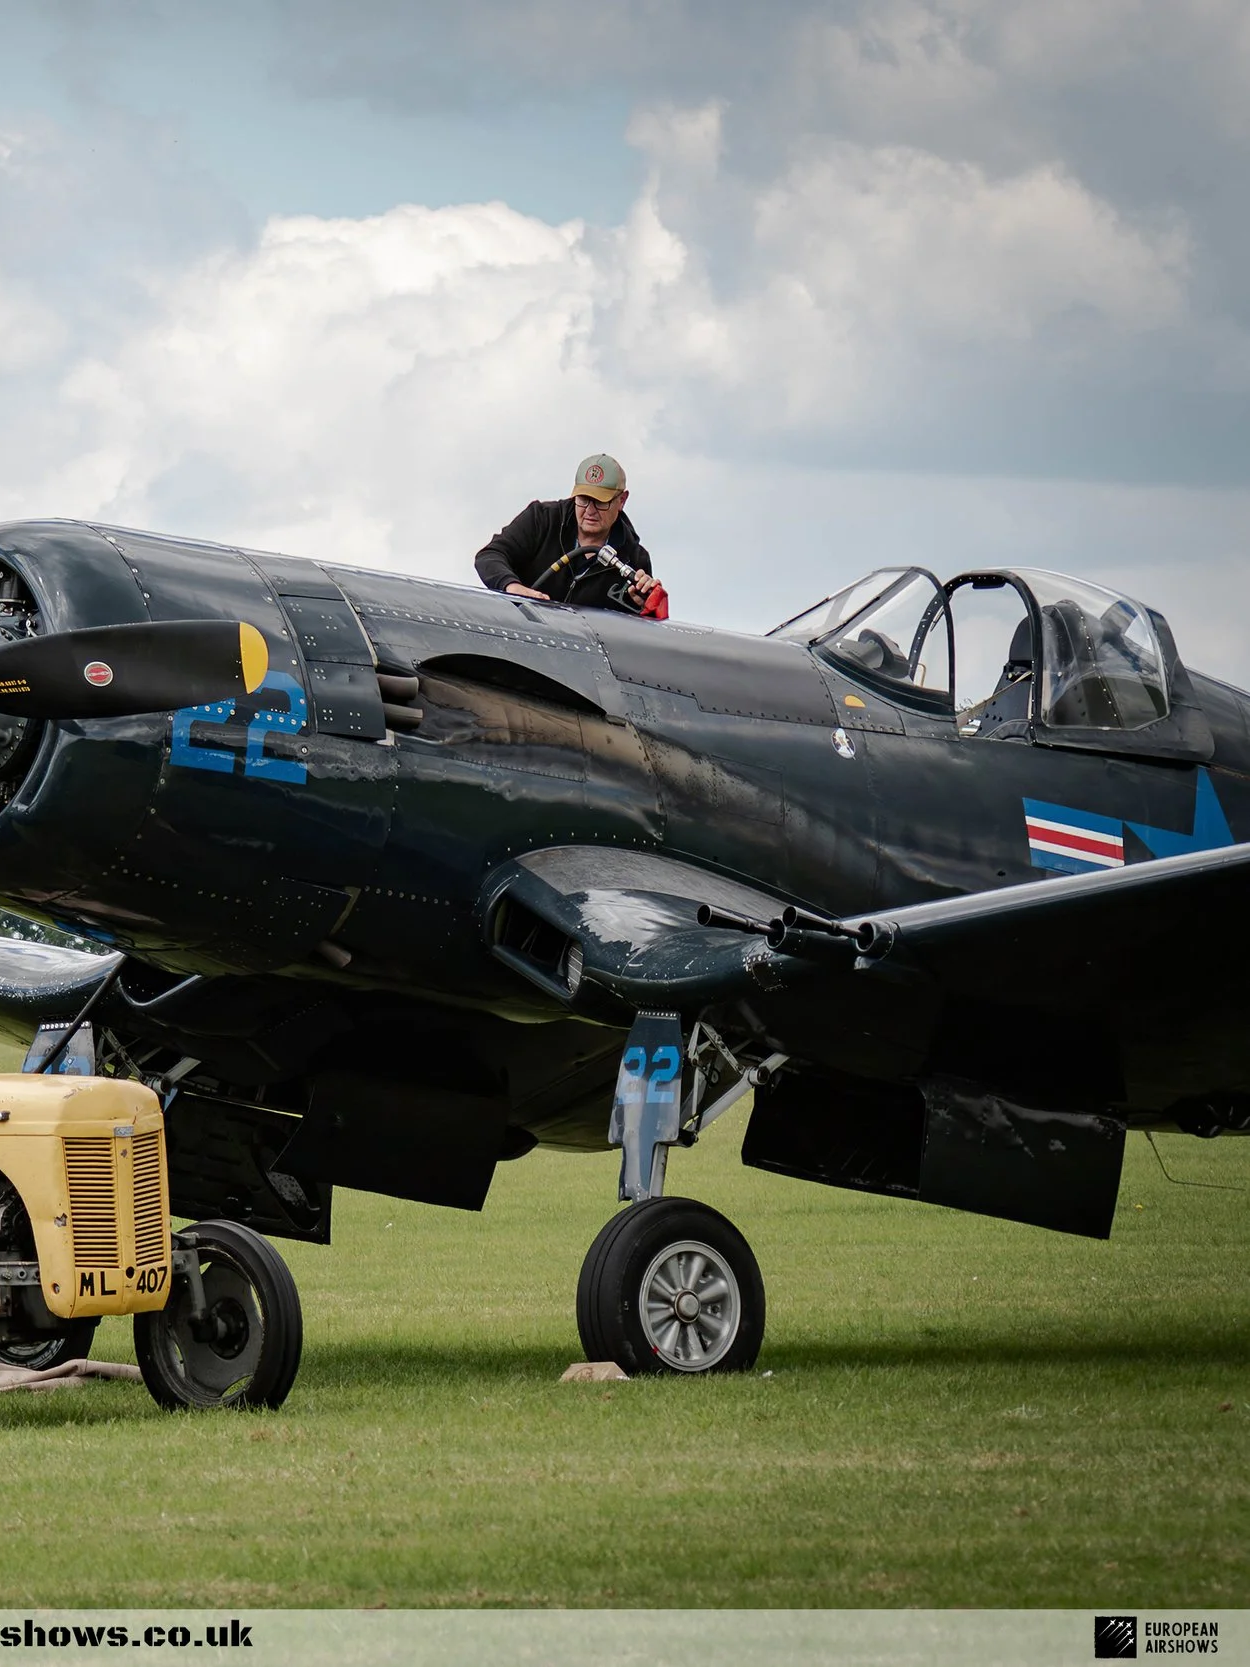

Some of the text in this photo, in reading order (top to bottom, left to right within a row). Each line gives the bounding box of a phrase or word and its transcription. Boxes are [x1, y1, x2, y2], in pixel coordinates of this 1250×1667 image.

[616, 1045, 680, 1105] 22
[79, 1266, 168, 1297] ML 407
